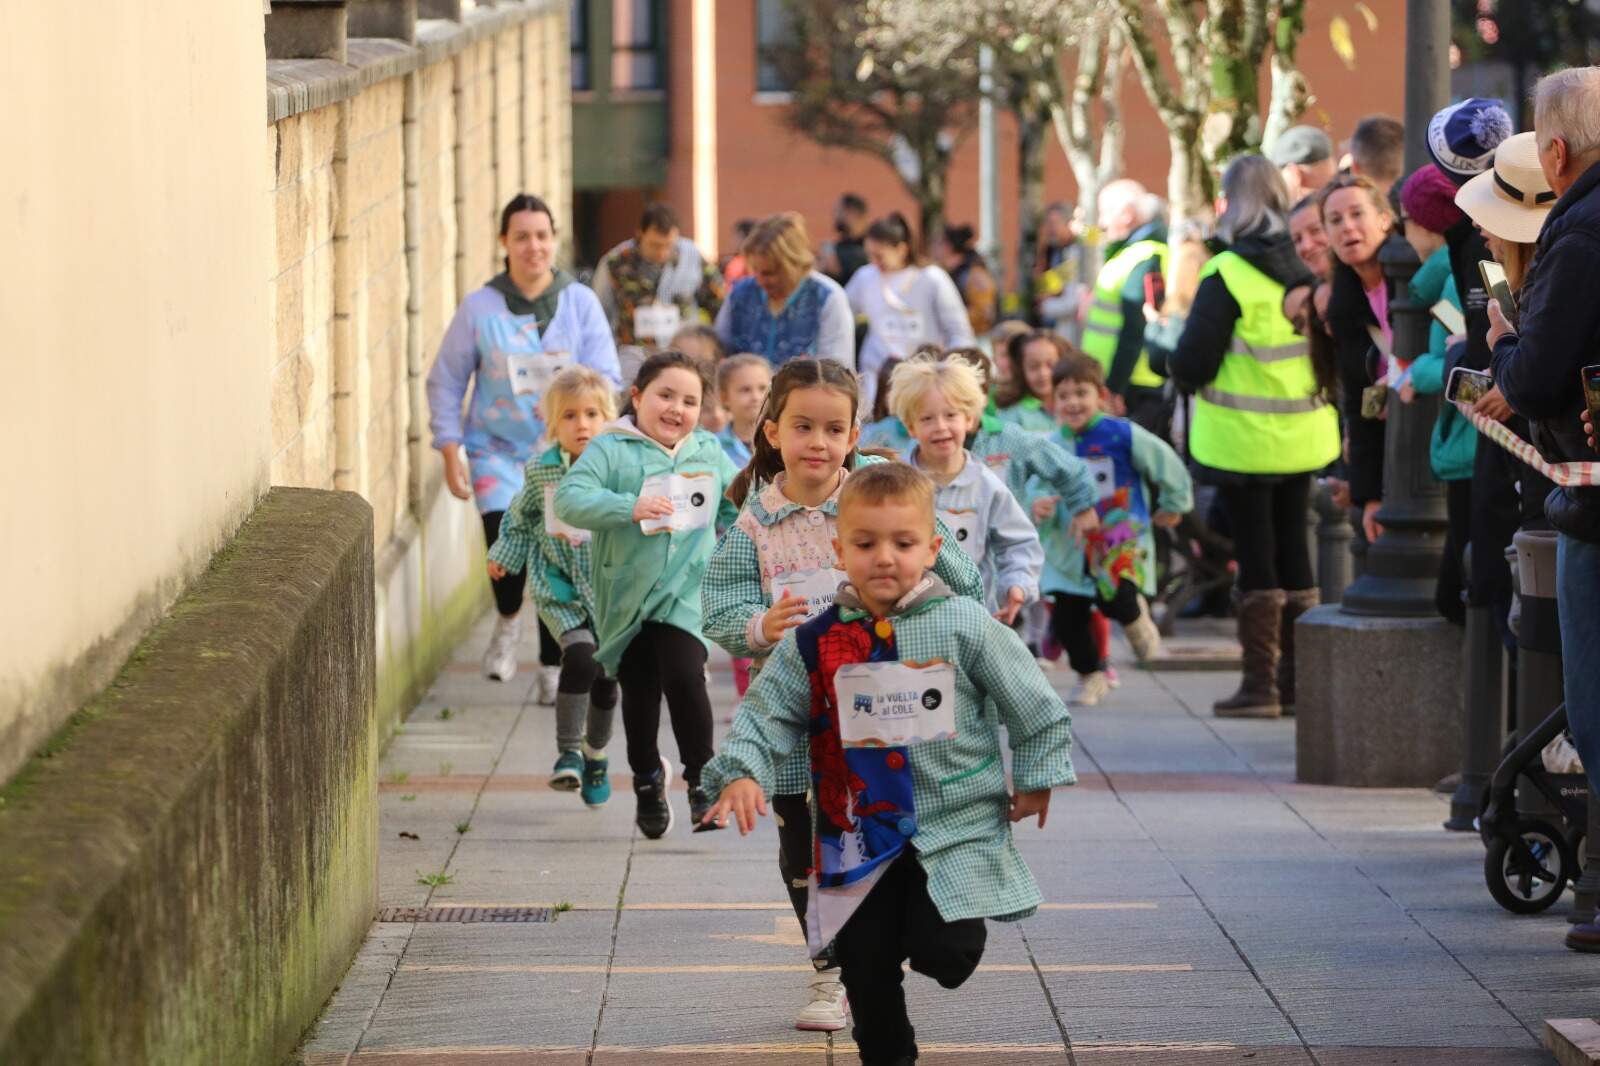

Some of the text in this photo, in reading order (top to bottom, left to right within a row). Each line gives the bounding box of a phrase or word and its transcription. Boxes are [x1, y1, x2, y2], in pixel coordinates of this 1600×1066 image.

[876, 693, 885, 703] la
[886, 691, 919, 702] VUELTA
[892, 704, 913, 714] COLE
